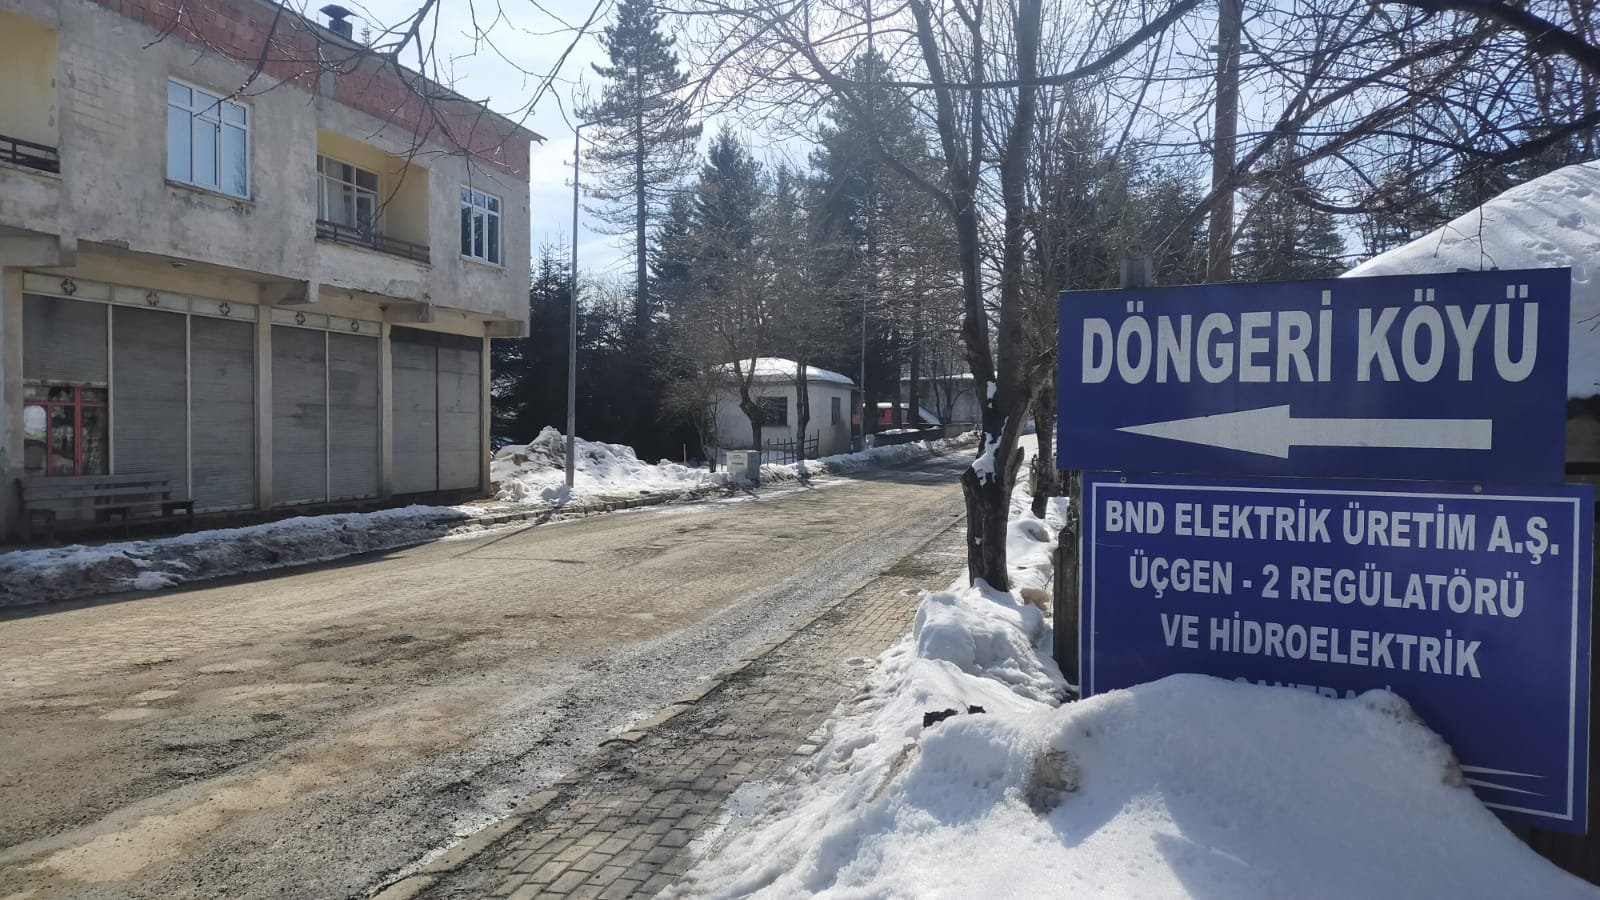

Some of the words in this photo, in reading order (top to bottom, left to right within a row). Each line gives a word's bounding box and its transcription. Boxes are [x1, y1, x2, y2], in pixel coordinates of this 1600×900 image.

[1082, 291, 1332, 384] DÖNGERİ
[1358, 285, 1538, 382] KÖYÜ
[1106, 501, 1164, 533] BND
[1176, 500, 1330, 542] ELEKTRİK
[1343, 502, 1475, 550] ÜRETİM
[1488, 516, 1558, 564] A.Ş.
[1129, 549, 1232, 598] ÜÇGEN
[1262, 565, 1279, 598] 2
[1291, 563, 1524, 617] REGÜLATÖRÜ
[1161, 614, 1198, 648] VE
[1209, 611, 1481, 678] HİDROELEKTRİK
